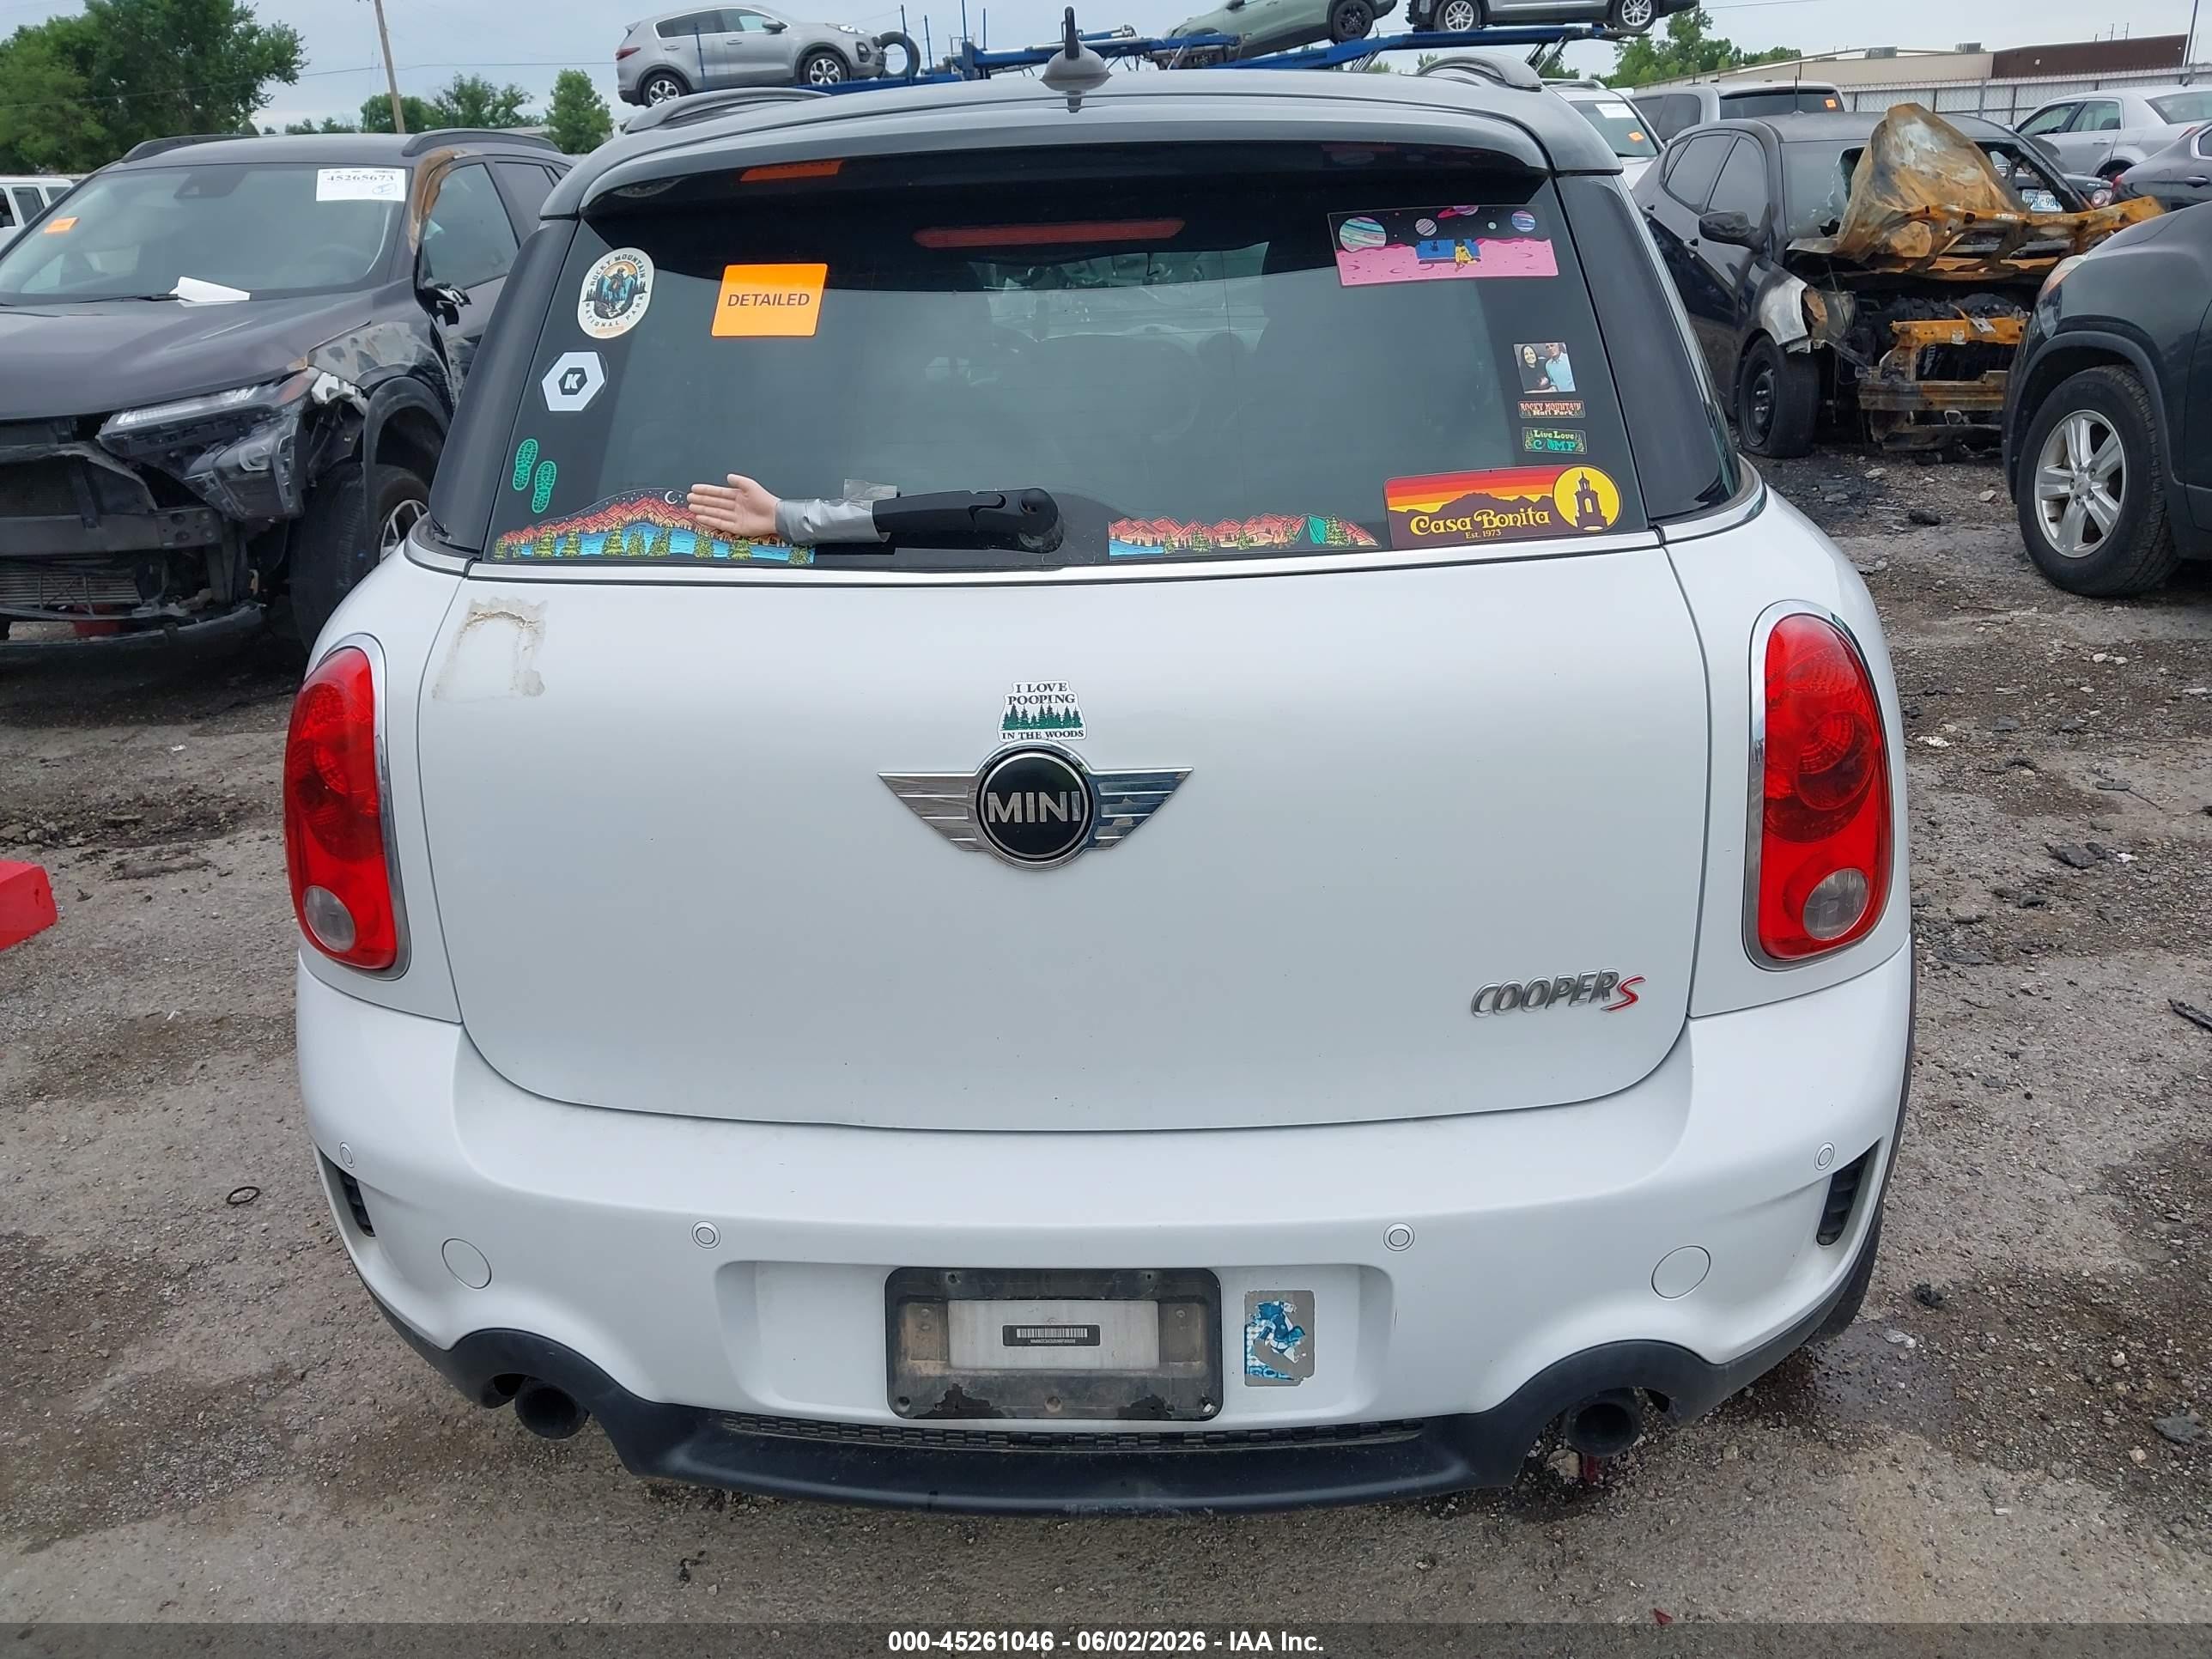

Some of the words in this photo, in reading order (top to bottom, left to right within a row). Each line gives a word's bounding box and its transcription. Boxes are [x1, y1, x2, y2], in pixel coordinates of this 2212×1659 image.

[590, 259, 611, 287] ROCKY
[614, 253, 646, 279] MOUNTAIN
[727, 293, 810, 307] DETAILED
[585, 301, 619, 327] NATIONAL
[625, 295, 644, 320] PARK
[563, 373, 581, 390] K
[1520, 403, 1543, 411] ROCKY
[1533, 429, 1553, 439] Live
[1553, 431, 1575, 440] Love
[1410, 515, 1473, 536] Casa
[1474, 507, 1551, 529] Bonita
[1483, 528, 1502, 538] 1973
[1016, 684, 1022, 693] I
[1027, 683, 1067, 693] LOVE
[1007, 694, 1075, 705] POOPING
[1018, 731, 1042, 739] THE
[1045, 730, 1085, 738] WOODS
[988, 791, 1080, 823] MINI
